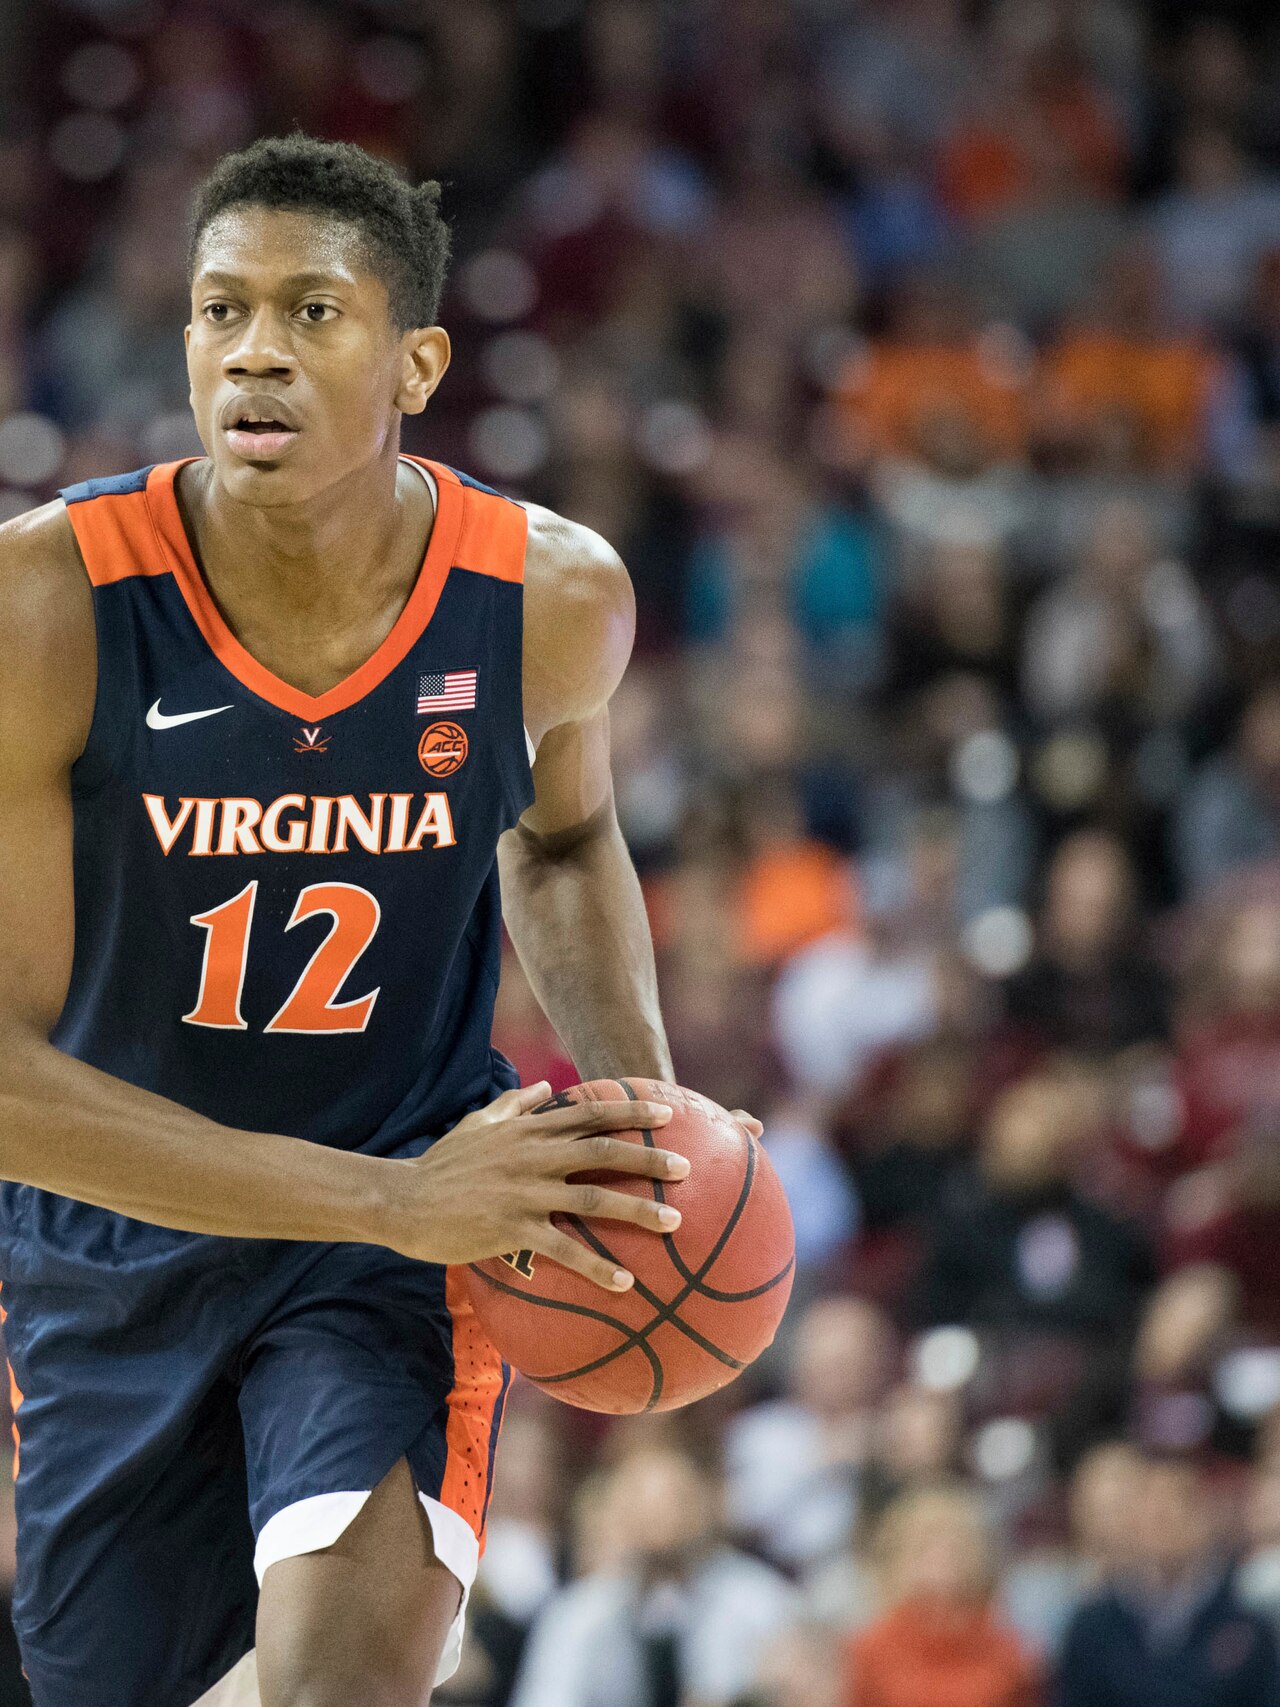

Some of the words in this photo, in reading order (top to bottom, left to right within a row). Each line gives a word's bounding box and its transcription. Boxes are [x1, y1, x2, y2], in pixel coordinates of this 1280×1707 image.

[301, 726, 322, 746] V
[426, 740, 464, 753] ACC
[142, 792, 457, 856] VIRGINIA
[181, 880, 380, 1034] 12
